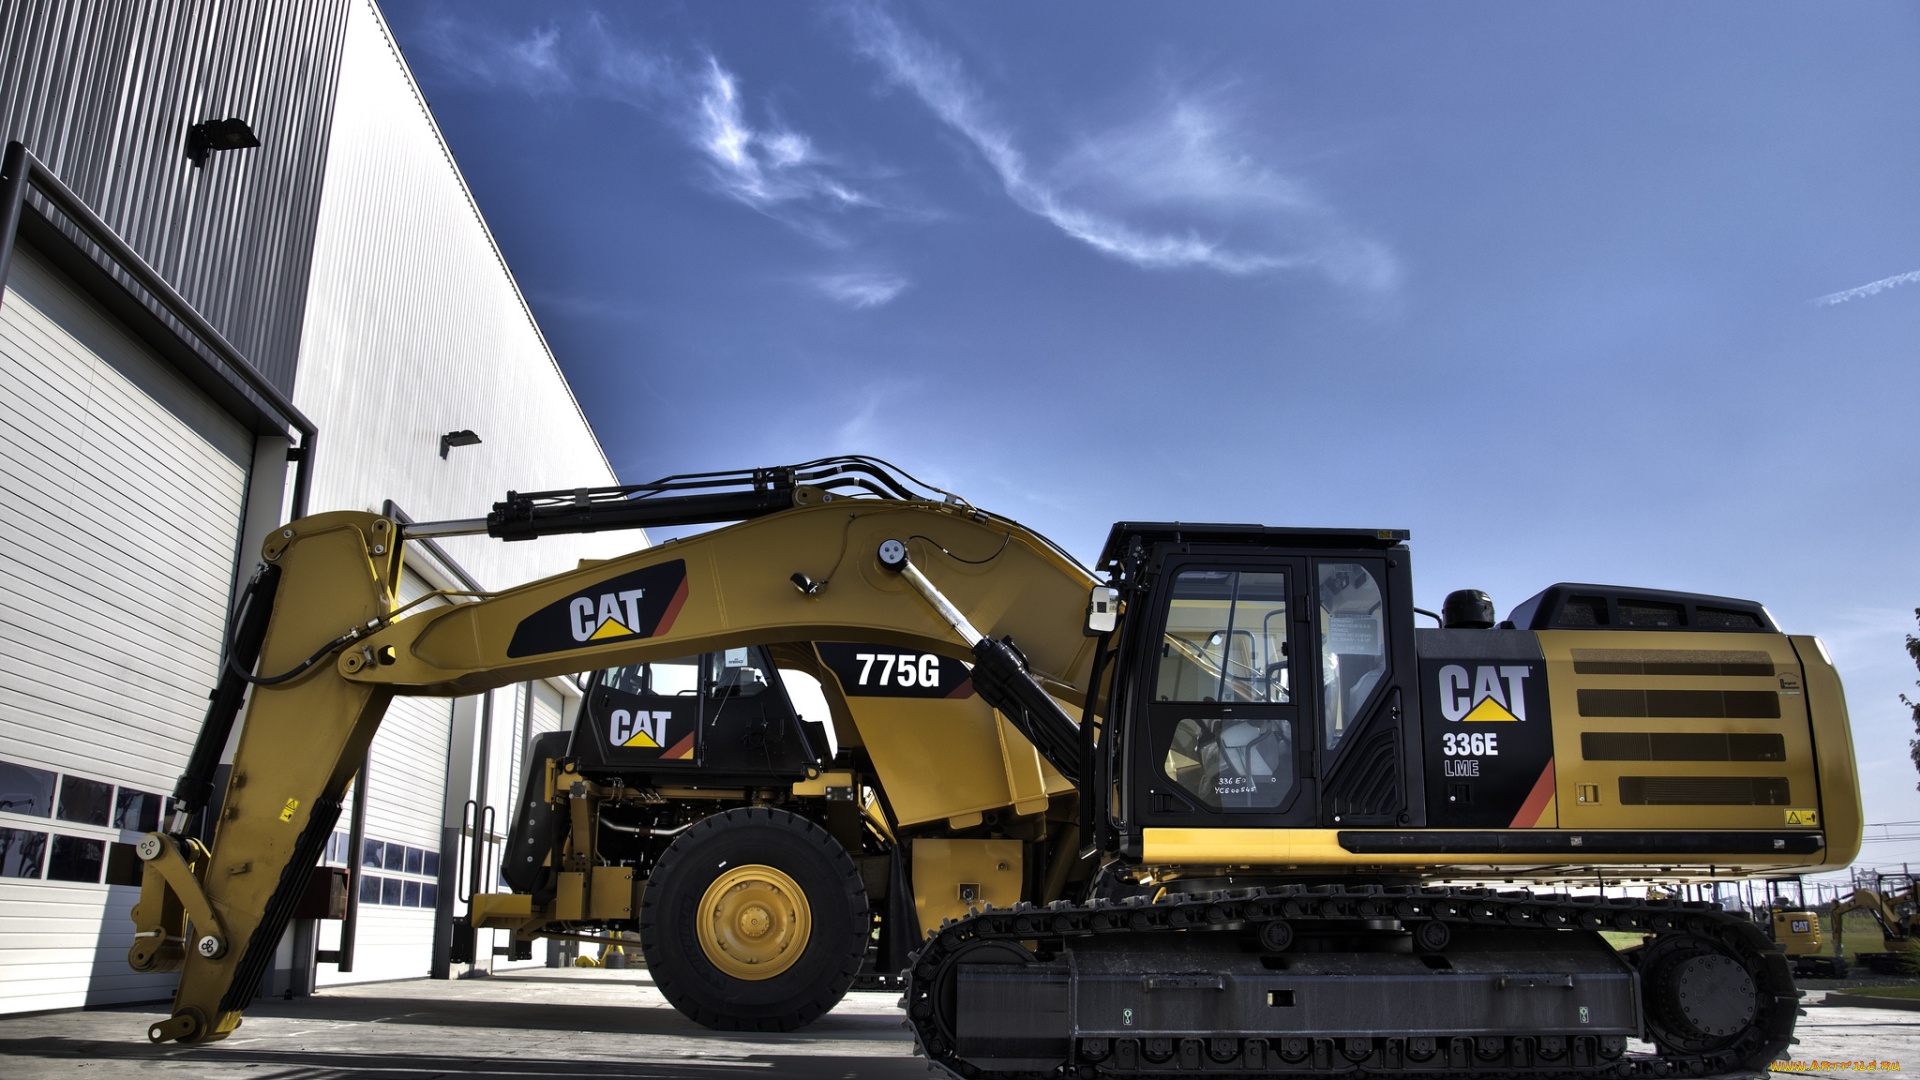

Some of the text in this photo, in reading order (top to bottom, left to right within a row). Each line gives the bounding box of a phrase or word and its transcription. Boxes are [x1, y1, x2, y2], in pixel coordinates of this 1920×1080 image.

[570, 588, 643, 642] CAT
[856, 653, 940, 688] 775G
[1438, 664, 1530, 722] CAT
[609, 709, 672, 748] CAT
[1442, 732, 1499, 756] 336E
[1444, 759, 1480, 777] LME
[1792, 921, 1809, 932] CAT
